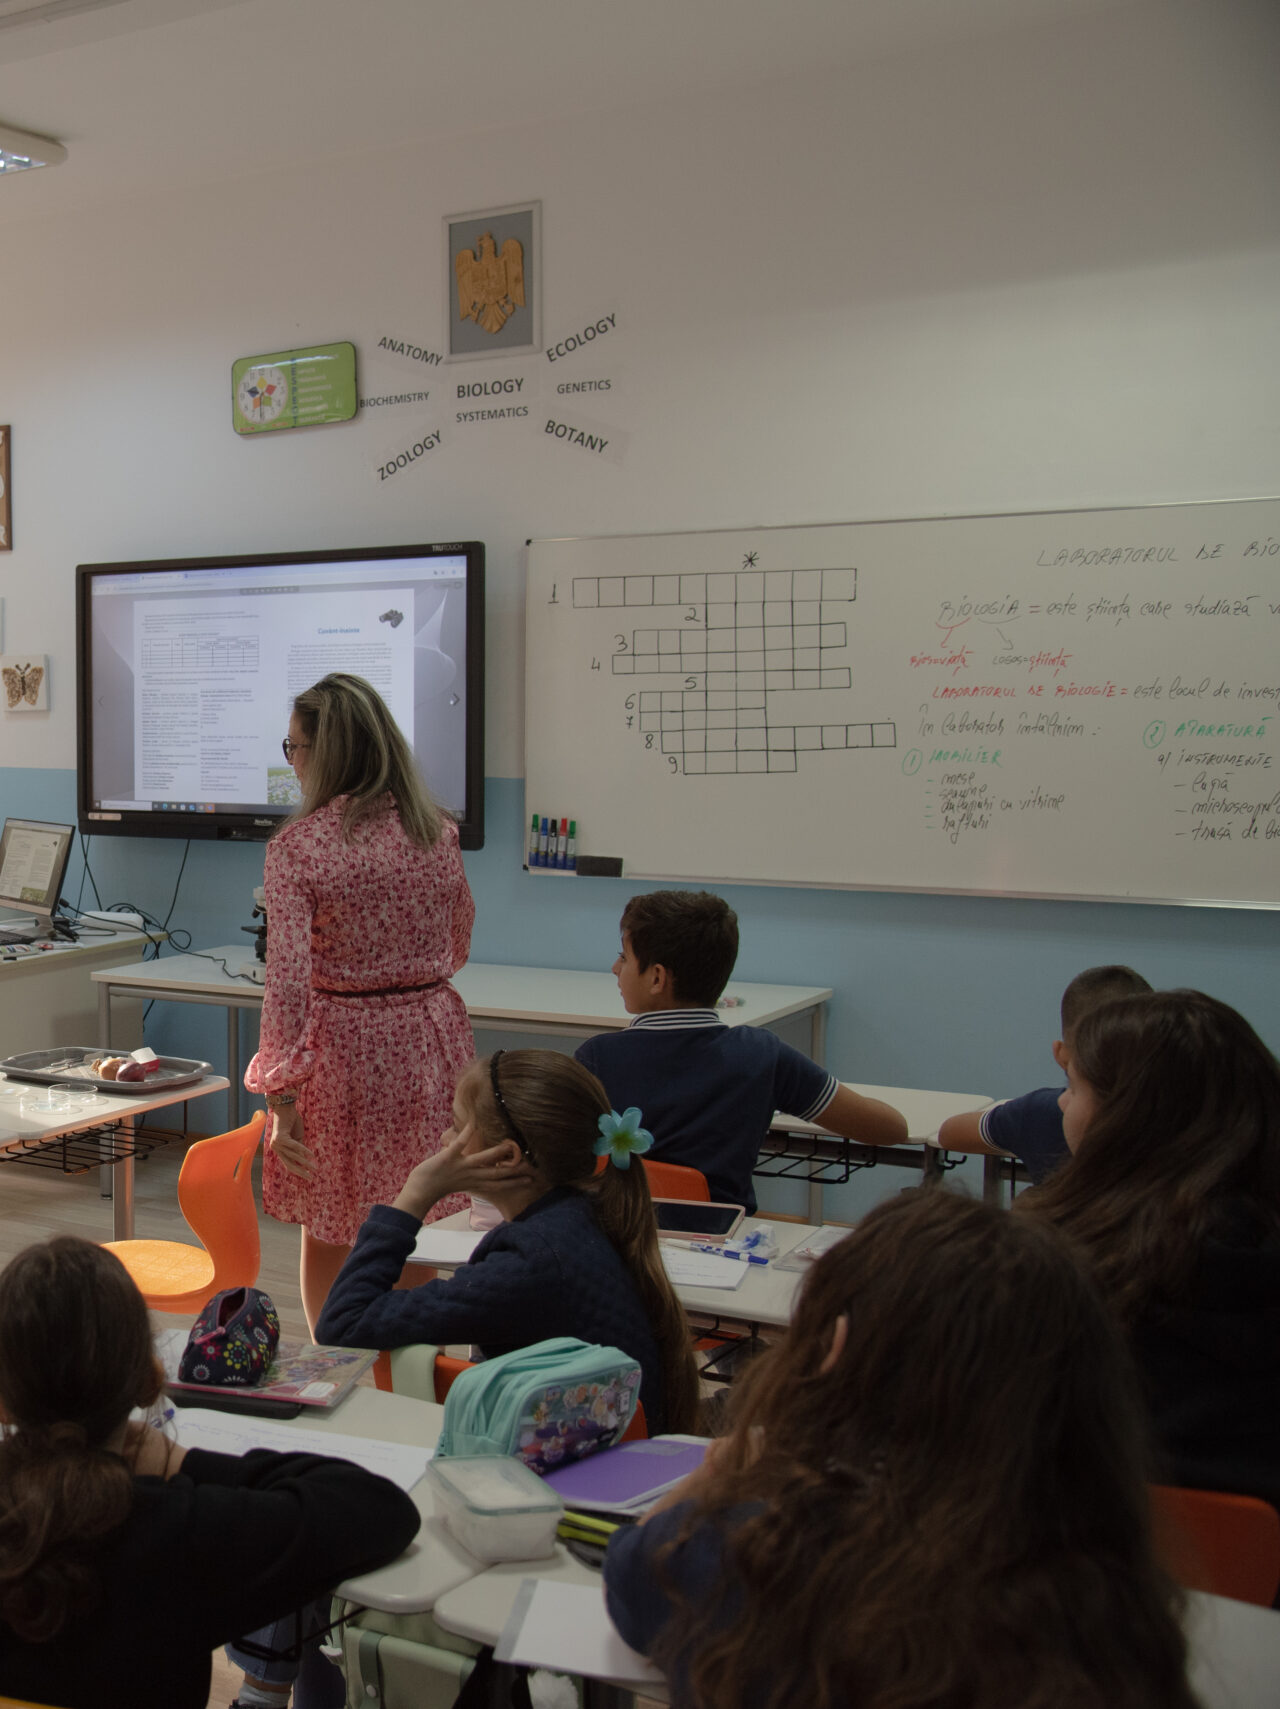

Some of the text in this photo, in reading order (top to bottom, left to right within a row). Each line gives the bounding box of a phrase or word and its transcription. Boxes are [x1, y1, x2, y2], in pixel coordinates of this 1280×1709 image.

[545, 312, 618, 363] ECOLOGY
[377, 336, 443, 367] ANATOMY
[456, 377, 524, 398] BIOLOGY
[556, 379, 612, 395] GENETICS
[360, 391, 430, 409] BIOCHEMISTRY
[456, 406, 529, 423] SYSTEMATICS
[544, 419, 608, 454] BOTANY
[376, 429, 443, 481] ZOOLOGY
[1036, 546, 1179, 567] LABORATORUL
[1195, 543, 1224, 560] DE
[547, 583, 560, 604] 1
[1046, 592, 1078, 616] este
[683, 607, 701, 622] 2
[613, 634, 628, 653] 3
[591, 656, 601, 672] 4
[684, 676, 698, 690] 5
[932, 685, 1017, 699] LABORATORUL
[1133, 677, 1162, 699] este
[1169, 676, 1210, 700] locul
[1213, 681, 1230, 699] de
[624, 693, 636, 711] 6
[624, 715, 633, 729] 7
